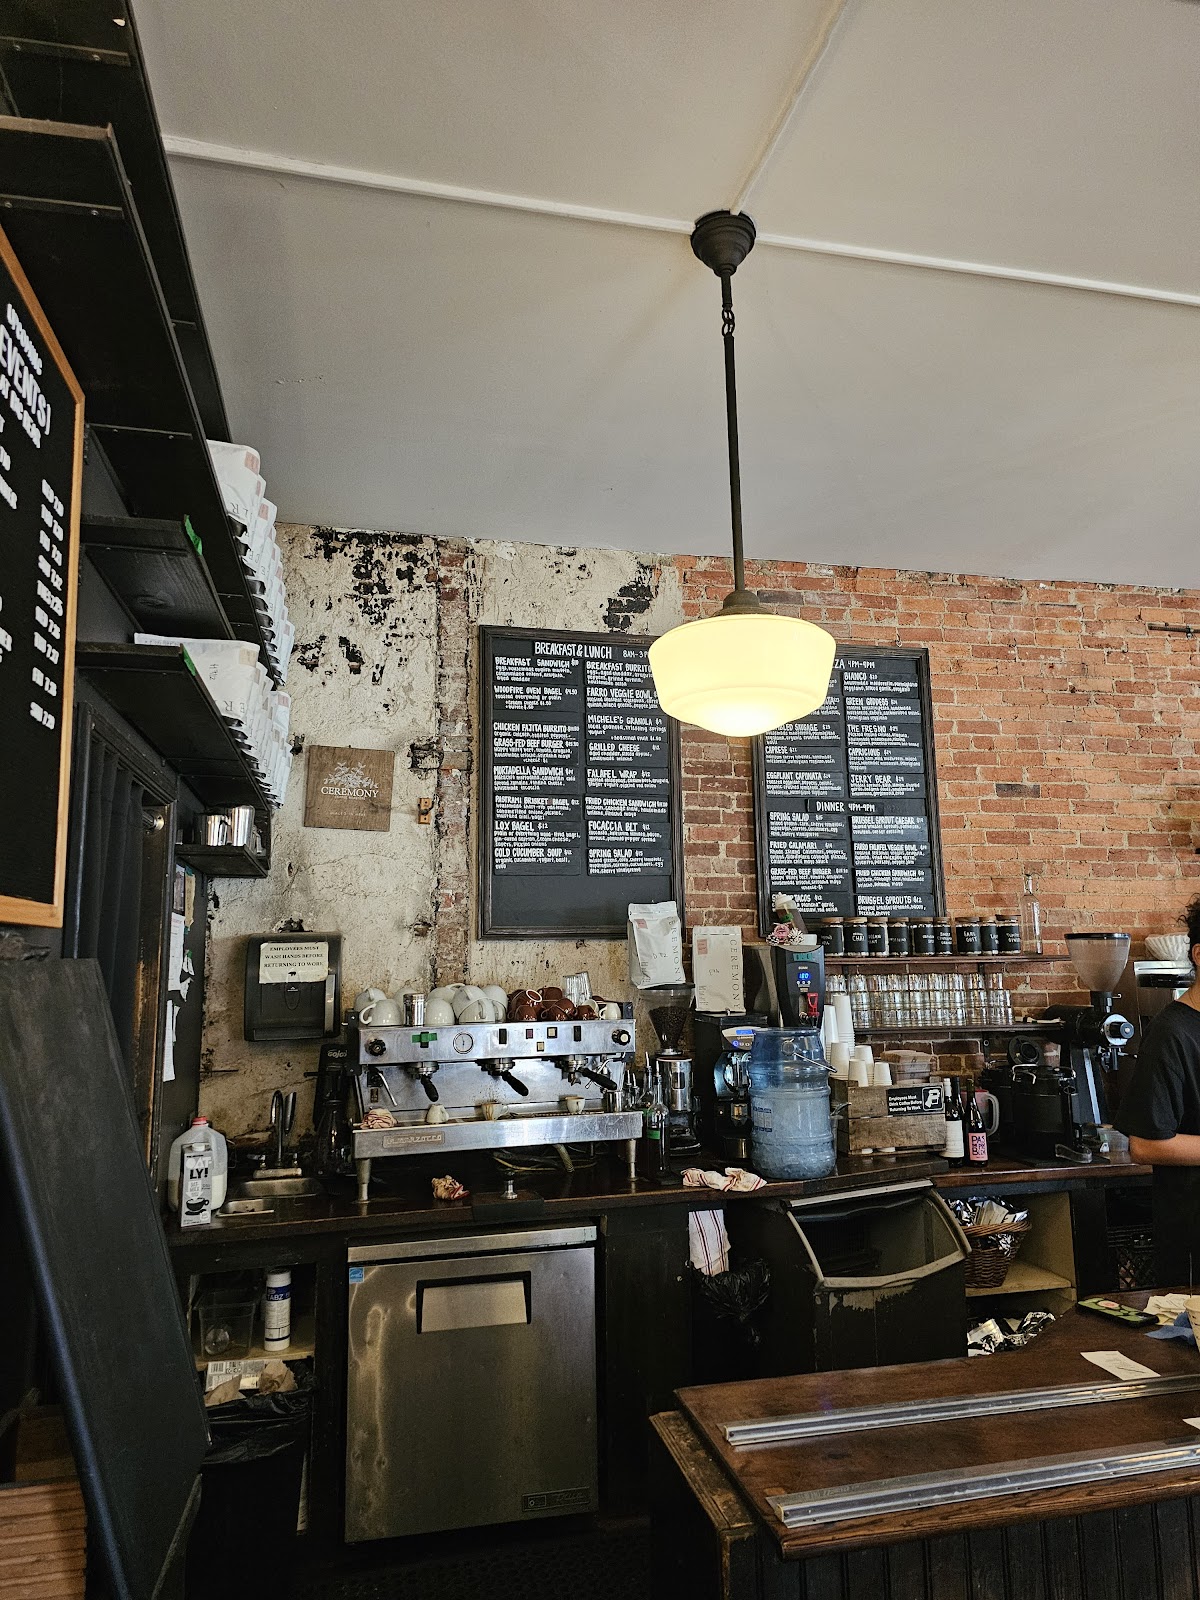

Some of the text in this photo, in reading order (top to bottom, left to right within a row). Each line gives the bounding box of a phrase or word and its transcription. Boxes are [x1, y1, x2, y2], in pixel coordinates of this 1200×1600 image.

[535, 642, 577, 656] BREAKFAST
[584, 645, 612, 659] LUNCH
[495, 657, 531, 666] BREAKFAST
[537, 659, 570, 668] SANDWICH
[587, 661, 623, 671] BREAKFAST
[844, 672, 867, 681] BIANCO
[494, 686, 524, 694] WOODFIRE
[587, 688, 652, 699] FARRO VEGGIE BOWL
[846, 697, 863, 706] GREEN
[588, 715, 624, 724] MICHELE'S
[627, 717, 652, 726] GRANOLA
[494, 723, 567, 733] CHICKEN FAJITA BURRITO
[862, 725, 886, 733] FRESNO
[494, 738, 564, 748] GRASS-FED BEEF BURGER
[589, 743, 615, 751] GRILLED
[619, 744, 640, 752] CHEESE
[765, 746, 788, 754] CAPRESE
[849, 748, 880, 756] CAPRICIOUS
[494, 766, 531, 775] MORTADELLA
[532, 766, 563, 776] SANDWICH
[587, 769, 617, 778] FALAFEL
[619, 770, 637, 778] WRAP
[767, 772, 822, 780] EGGPLANT CAPONATA
[851, 775, 892, 783] JERRY BEAR
[321, 786, 379, 798] CEREMONY
[495, 795, 522, 803] PASTRAMI
[524, 797, 548, 805] BRISKET
[585, 797, 656, 808] FRIED CHICKEN SANDWICH
[816, 802, 845, 812] DINNER
[770, 812, 810, 822] SPRING SALAD
[852, 816, 915, 825] BRUSSEL SPROUT CAESAR
[495, 821, 510, 830] LOX
[512, 822, 534, 831] BAGEL
[589, 821, 622, 831] FOCACCIA
[625, 822, 638, 831] BLT
[770, 841, 787, 849] FRIED
[495, 848, 510, 857] COLD
[512, 848, 544, 857] CUCUMBER
[547, 849, 563, 857] SOUP
[589, 849, 611, 857] SPRING
[613, 849, 632, 858] SALAD
[771, 868, 797, 876] GRASS-FED
[794, 895, 811, 903] TACOS
[858, 896, 884, 904] BRUSSEL
[885, 896, 911, 905] SPROUTS
[730, 940, 741, 1009] CEREMONY
[190, 1168, 209, 1179] LY!
